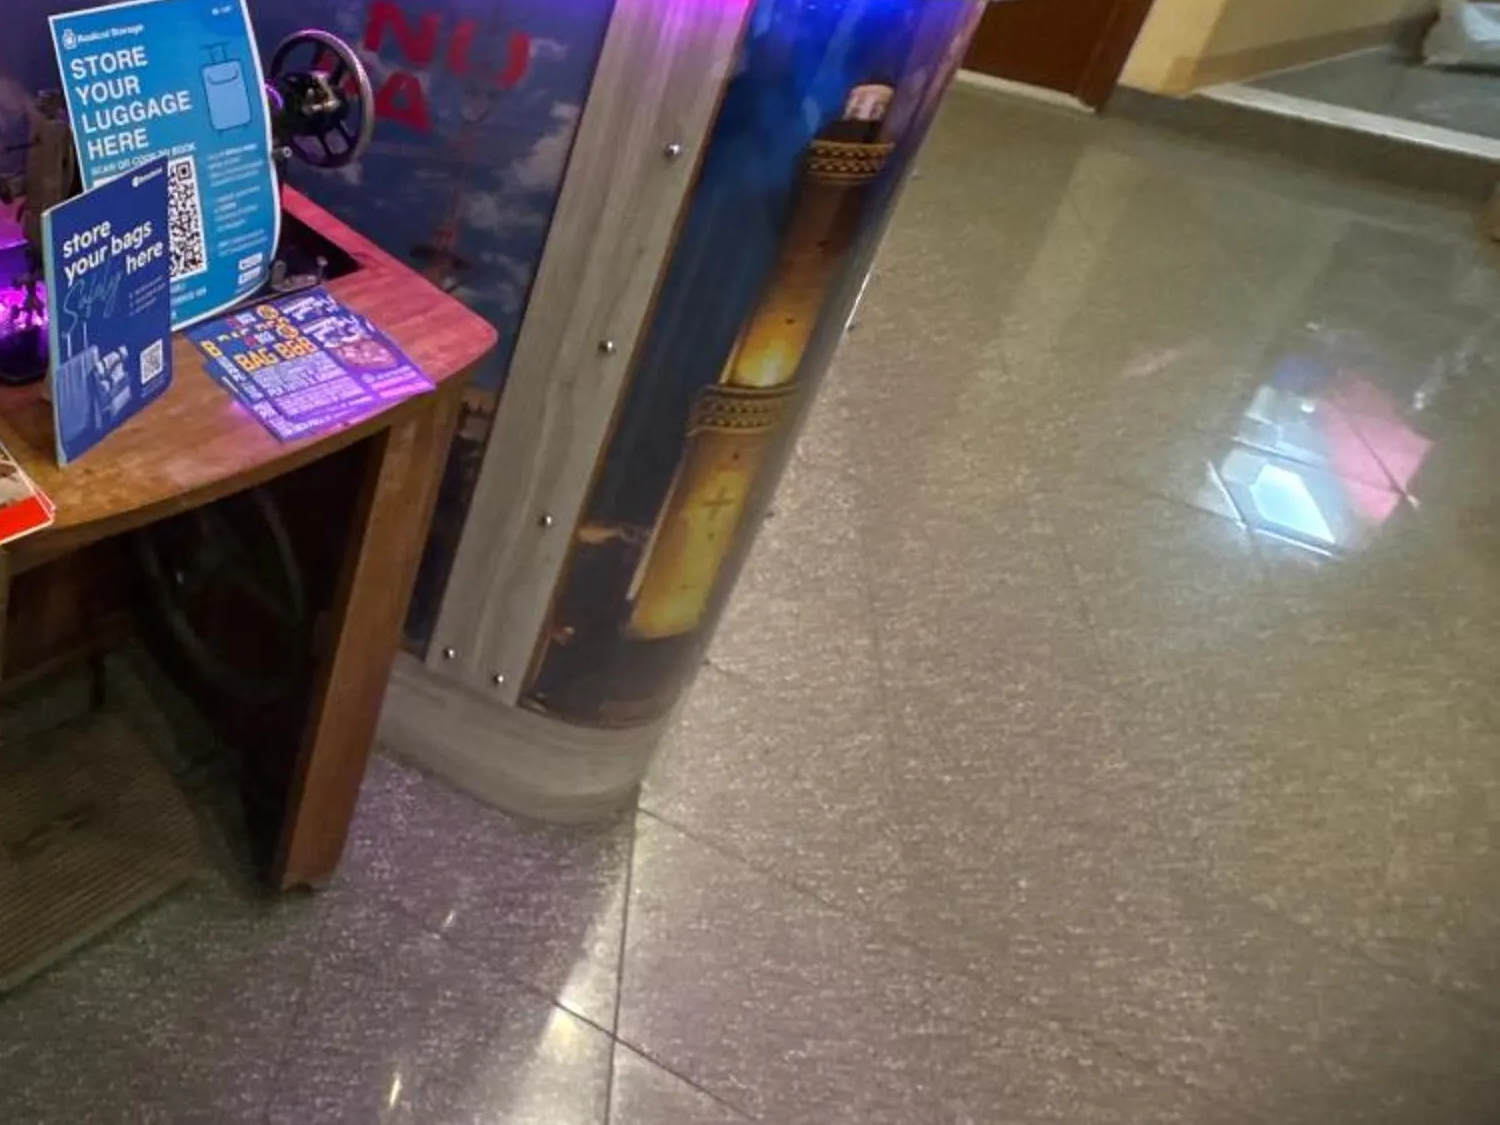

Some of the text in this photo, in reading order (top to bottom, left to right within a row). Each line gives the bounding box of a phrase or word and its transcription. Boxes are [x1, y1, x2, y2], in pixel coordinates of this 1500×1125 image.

[69, 45, 149, 81] STORE
[75, 75, 142, 107] YOUR
[81, 90, 194, 135] LUGGAGE
[87, 128, 150, 160] HERE
[63, 220, 112, 259] store
[63, 220, 153, 287] your bags
[126, 240, 164, 275] here
